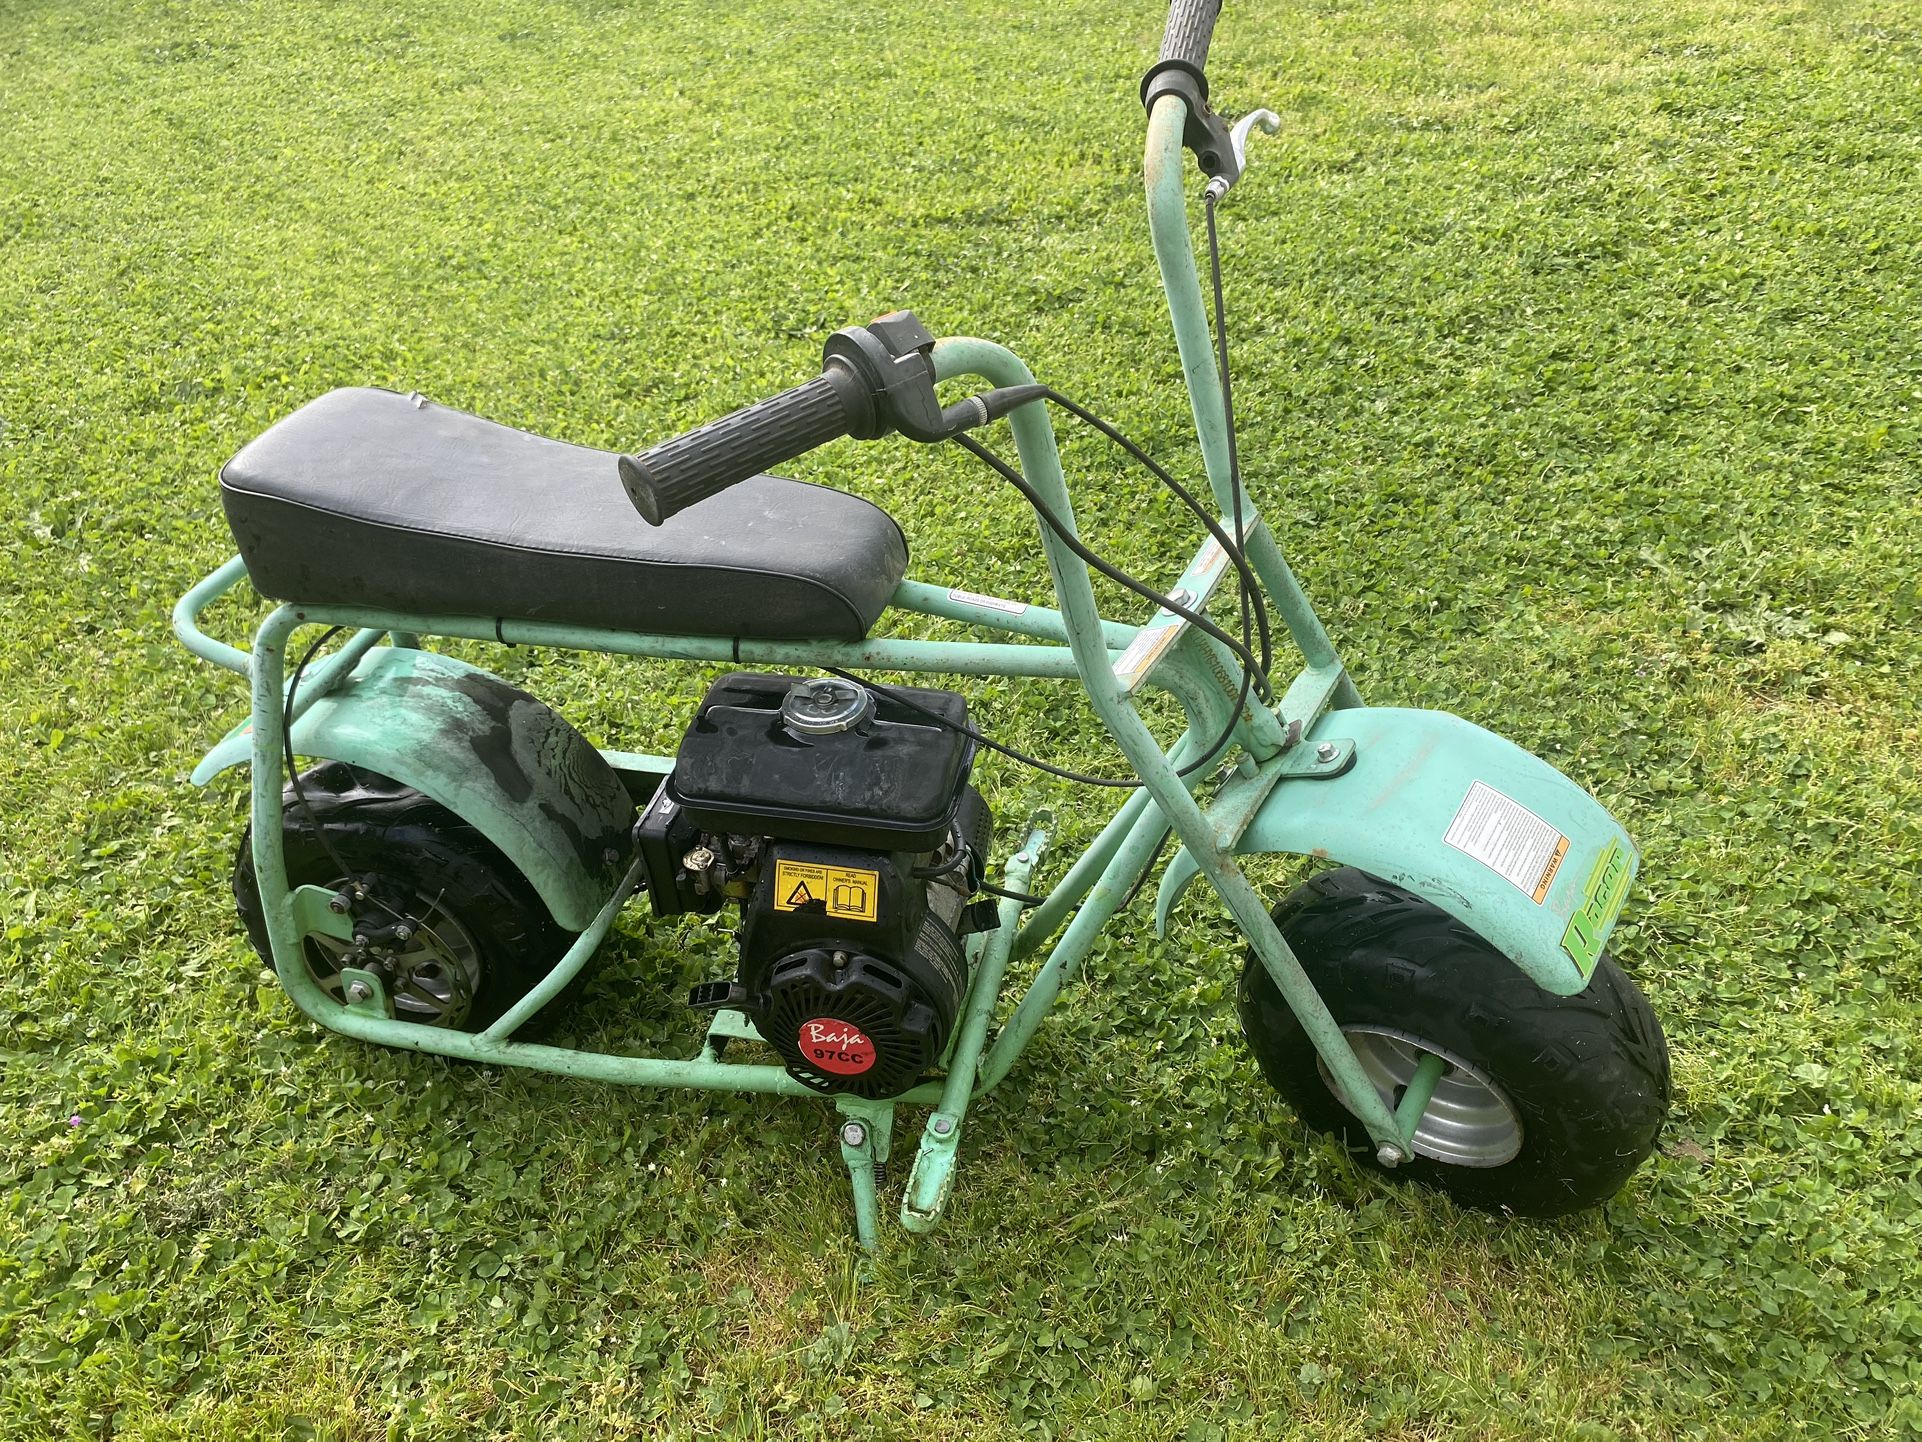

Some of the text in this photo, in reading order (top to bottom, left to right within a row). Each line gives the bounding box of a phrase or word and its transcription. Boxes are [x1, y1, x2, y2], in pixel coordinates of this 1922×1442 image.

[1540, 857, 1559, 890] WARNING
[807, 1023, 864, 1051] Baja
[813, 1048, 864, 1064] 97CC
